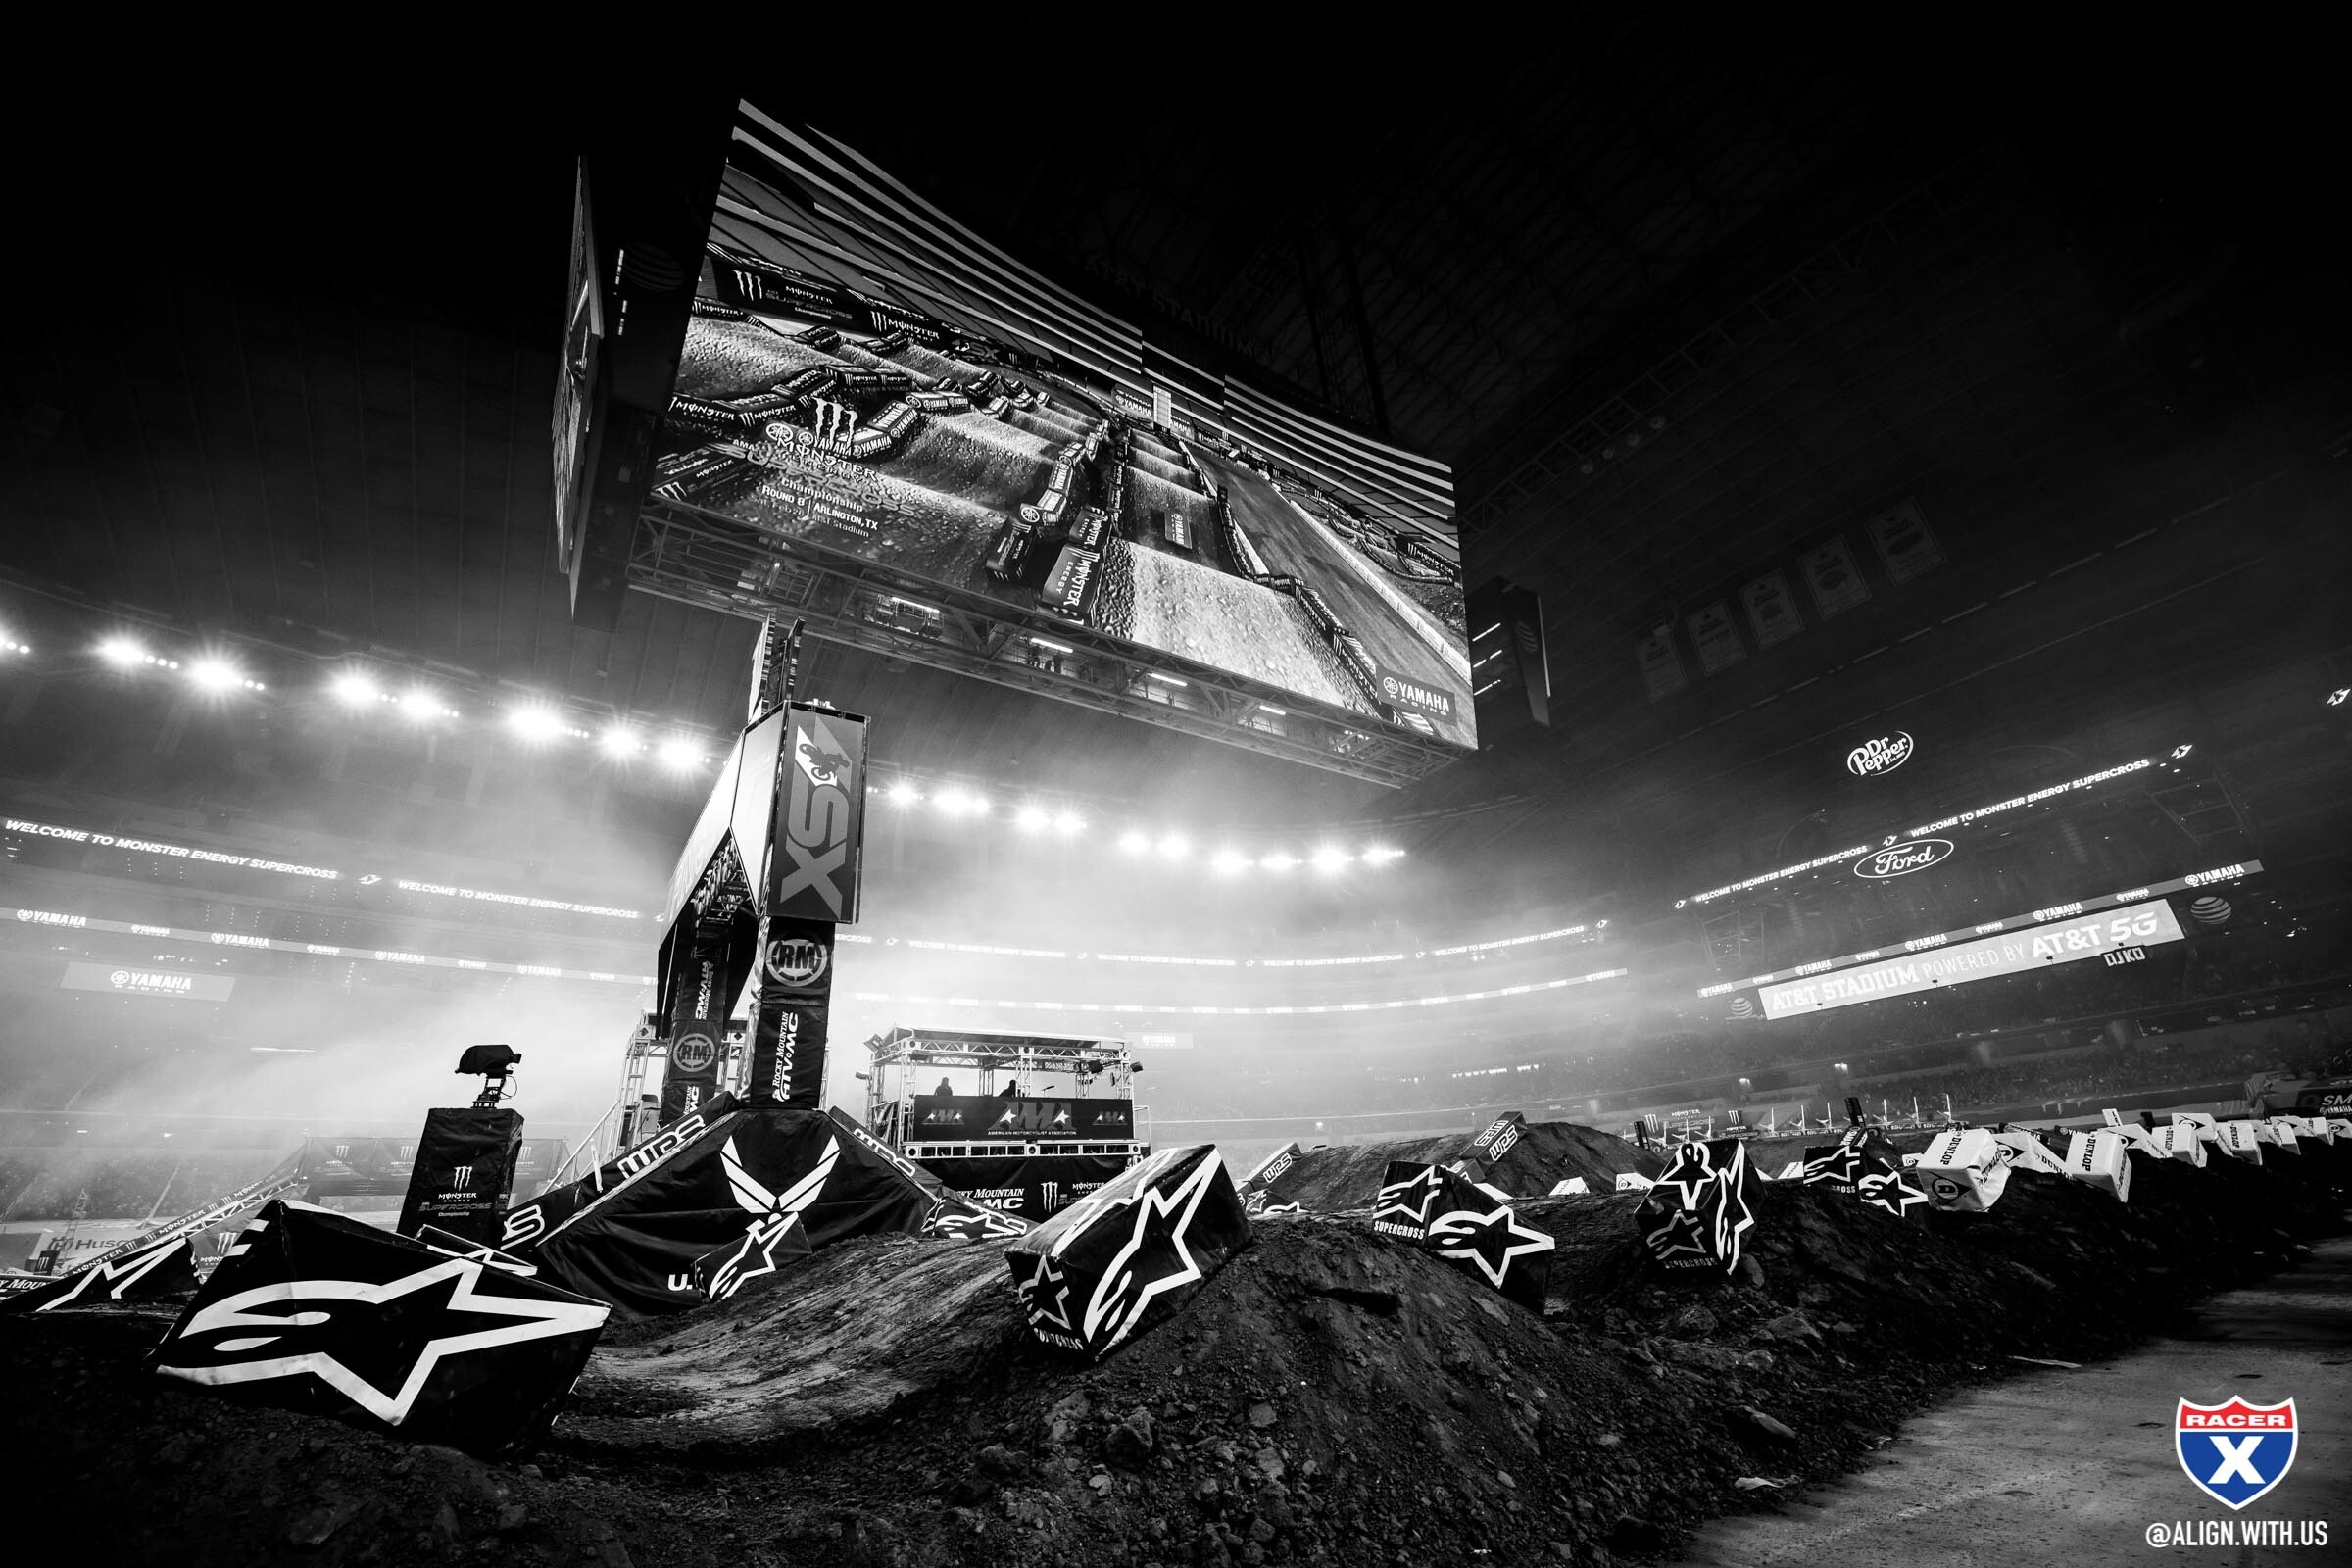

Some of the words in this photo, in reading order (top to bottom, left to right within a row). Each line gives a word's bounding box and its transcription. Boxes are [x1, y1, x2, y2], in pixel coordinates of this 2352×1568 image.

[888, 319, 939, 339] MONSTER
[676, 402, 734, 419] MONSTER
[755, 405, 796, 419] MONSTER
[861, 436, 892, 453] YAMAHA
[696, 459, 734, 478] MONSTER
[777, 438, 878, 482] MONSTER
[762, 485, 794, 502] ROUND
[782, 479, 862, 512] Championship
[1063, 559, 1092, 606] MONSTER
[1399, 682, 1450, 712] YAMAHA
[1849, 737, 1907, 776] Pepper
[1864, 737, 1889, 758] Dr
[1911, 817, 1958, 837] WELCOME
[1960, 812, 1974, 823] TO
[1976, 796, 2026, 818] MONSTER
[2027, 782, 2070, 803] ENERGY
[2072, 759, 2150, 788] SUPERCROSS
[6, 819, 88, 842] WELCOME
[92, 833, 114, 846] TO
[116, 839, 190, 858] MONSTER
[191, 849, 250, 866] ENERGY
[250, 858, 338, 879] SUPERCROSS
[1875, 845, 1935, 874] Ford
[1695, 886, 1731, 902] WELCOME
[1733, 882, 1742, 892] TO
[1742, 872, 1779, 888] MONSTER
[1780, 862, 1811, 877] ENERGY
[1813, 845, 1868, 868] SUPERCROSS
[2197, 864, 2244, 883] YAMAHA
[398, 880, 456, 896] WELCOME
[459, 888, 474, 898] TO
[475, 891, 527, 906] MONSTER
[530, 898, 572, 910] ENERGY
[572, 904, 639, 919] SUPERCROSS
[2043, 902, 2083, 918] YAMAHA
[33, 911, 86, 927] YAMAHA
[225, 933, 269, 949] YAMAHA
[1435, 947, 1468, 956] WELCOME
[1540, 925, 1585, 941] SUPERCROSS
[1914, 933, 1948, 949] YAMAHA
[387, 953, 425, 964] YAMAHA
[779, 944, 815, 969] RM
[1772, 986, 1822, 1010] AT&T
[1821, 966, 1917, 1000] STADIUM
[1923, 949, 1999, 979] POWERED
[2008, 943, 2025, 961] BY
[2033, 923, 2102, 958] AT&T
[2110, 912, 2158, 942] 5G
[131, 972, 192, 990] YAMAHA
[776, 1011, 788, 1058] MOUNTAIN
[772, 1058, 783, 1088] ROCKY
[1490, 1125, 1517, 1161] WPS
[1940, 1137, 1962, 1165] DUNLOP
[2082, 1138, 2097, 1172] DUNLOP
[1263, 1152, 1292, 1184] WPS
[972, 1188, 1025, 1198] MOUNTAIN
[159, 1209, 206, 1235] MONSTER
[1374, 1220, 1425, 1240] SUPERCROSS
[73, 1249, 123, 1275] MONSTER
